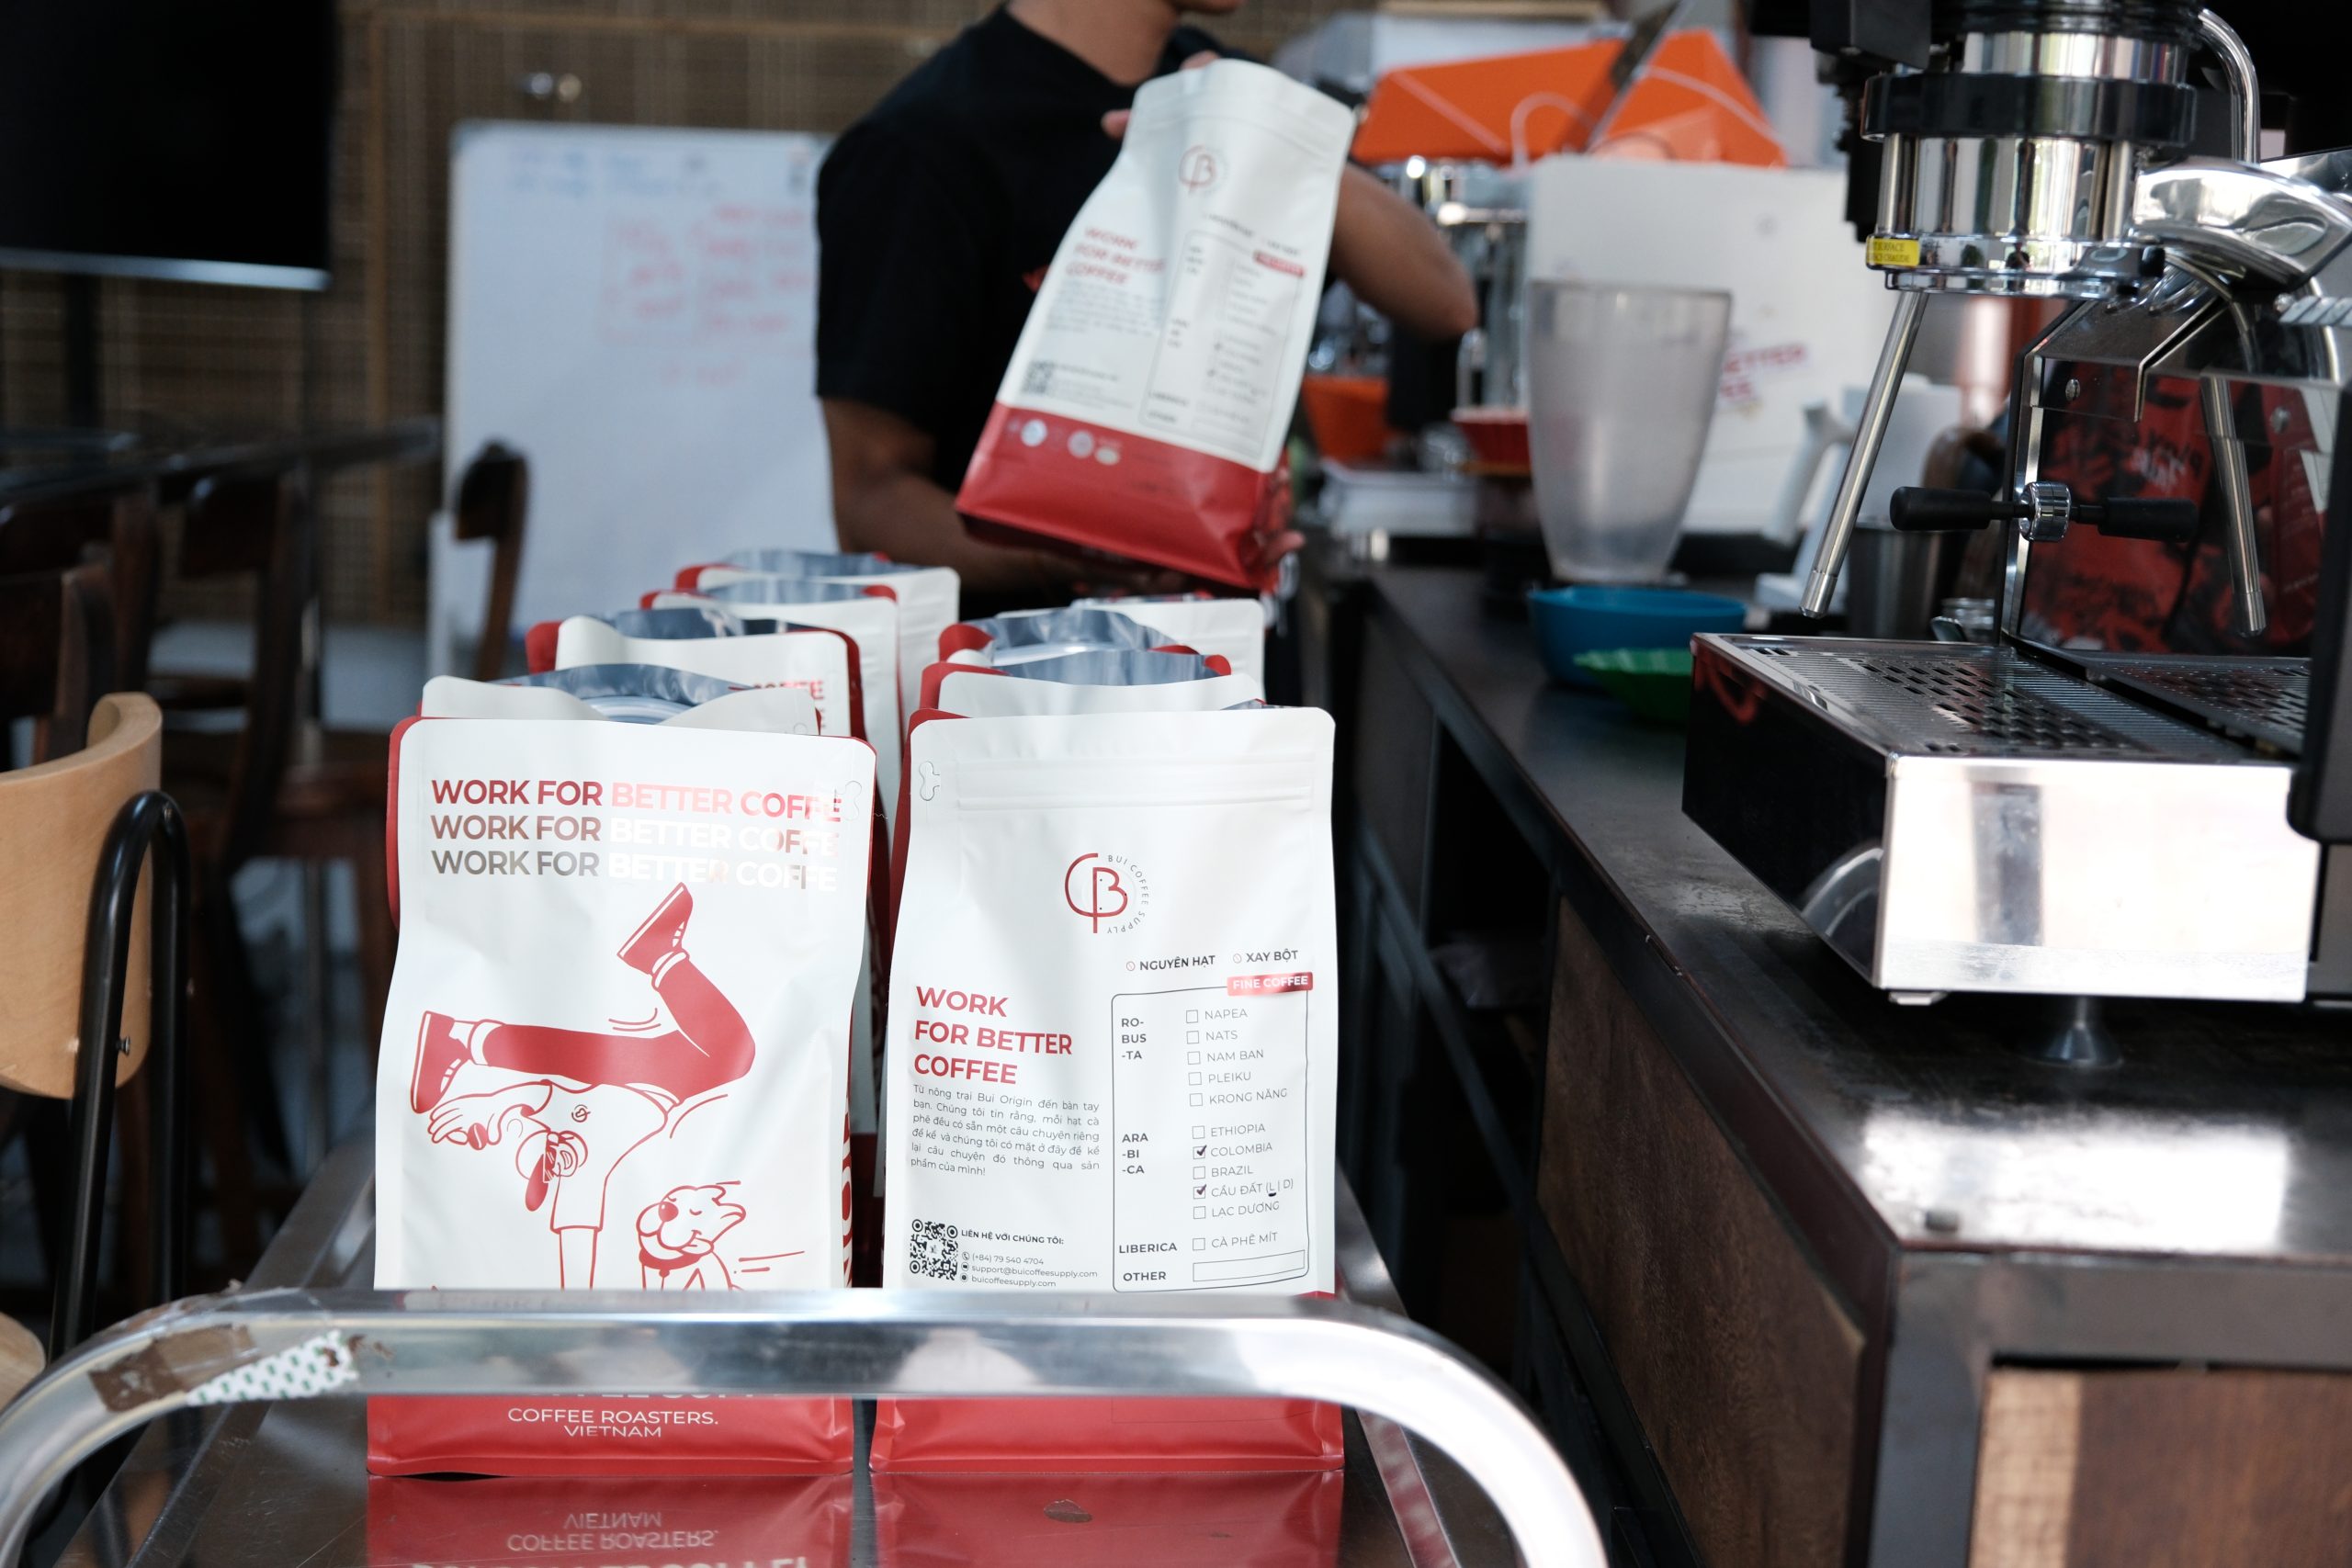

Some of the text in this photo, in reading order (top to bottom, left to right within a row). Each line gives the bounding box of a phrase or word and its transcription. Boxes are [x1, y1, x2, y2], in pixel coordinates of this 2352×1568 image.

[430, 779, 530, 807] WORK
[537, 780, 603, 807] FOR
[611, 781, 734, 815] BETTER
[430, 815, 530, 840] WORK
[537, 815, 601, 841] FOR
[609, 817, 732, 850] BETTER
[430, 849, 530, 875] WORK
[537, 851, 600, 876] FOR
[608, 852, 729, 884] BETTER
[1107, 854, 1149, 934] BUI COFFEE SUPPLY
[1246, 948, 1298, 963] XAY BỘT
[1139, 954, 1216, 971] NGUYÊN HẠT
[1233, 975, 1308, 990] FINE COFFEE
[916, 986, 1009, 1017] WORK
[1204, 1009, 1249, 1020] NAPEA
[1121, 1017, 1144, 1028] RO-
[915, 1020, 1072, 1055] FOR BETTER
[1122, 1033, 1147, 1043] BUS
[1205, 1030, 1238, 1042] NATS
[1122, 1050, 1143, 1060] -TA
[1207, 1049, 1264, 1063] NAM BAN
[914, 1054, 1018, 1084] COFFEE
[1208, 1071, 1251, 1084] PLEIKU
[1000, 1095, 1033, 1107] Origin
[1083, 1102, 1099, 1112] tay
[1209, 1091, 1252, 1105] KRONG
[990, 1110, 1004, 1118] tin
[1211, 1123, 1266, 1137] ETHIOPIA
[1122, 1134, 1148, 1143] ARA
[1122, 1149, 1139, 1158] -BI
[1210, 1142, 1272, 1157] COLOMBIA
[1052, 1162, 1073, 1170] qua
[1122, 1165, 1145, 1174] -CA
[1211, 1165, 1254, 1178] BRAZIL
[1231, 1233, 1256, 1247] PHÊ
[1118, 1242, 1177, 1254] LIBERICA
[993, 1255, 1004, 1263] 79
[1005, 1256, 1022, 1264] 540
[1023, 1257, 1044, 1265] 4704
[971, 1265, 1098, 1278] support@buicoffeesupply.com
[1123, 1271, 1167, 1281] OTHER
[971, 1275, 1057, 1288] buicoffeesupply.com
[507, 1407, 718, 1426] COFFEE ROASTERS.
[563, 1425, 662, 1438] VIETNAM
